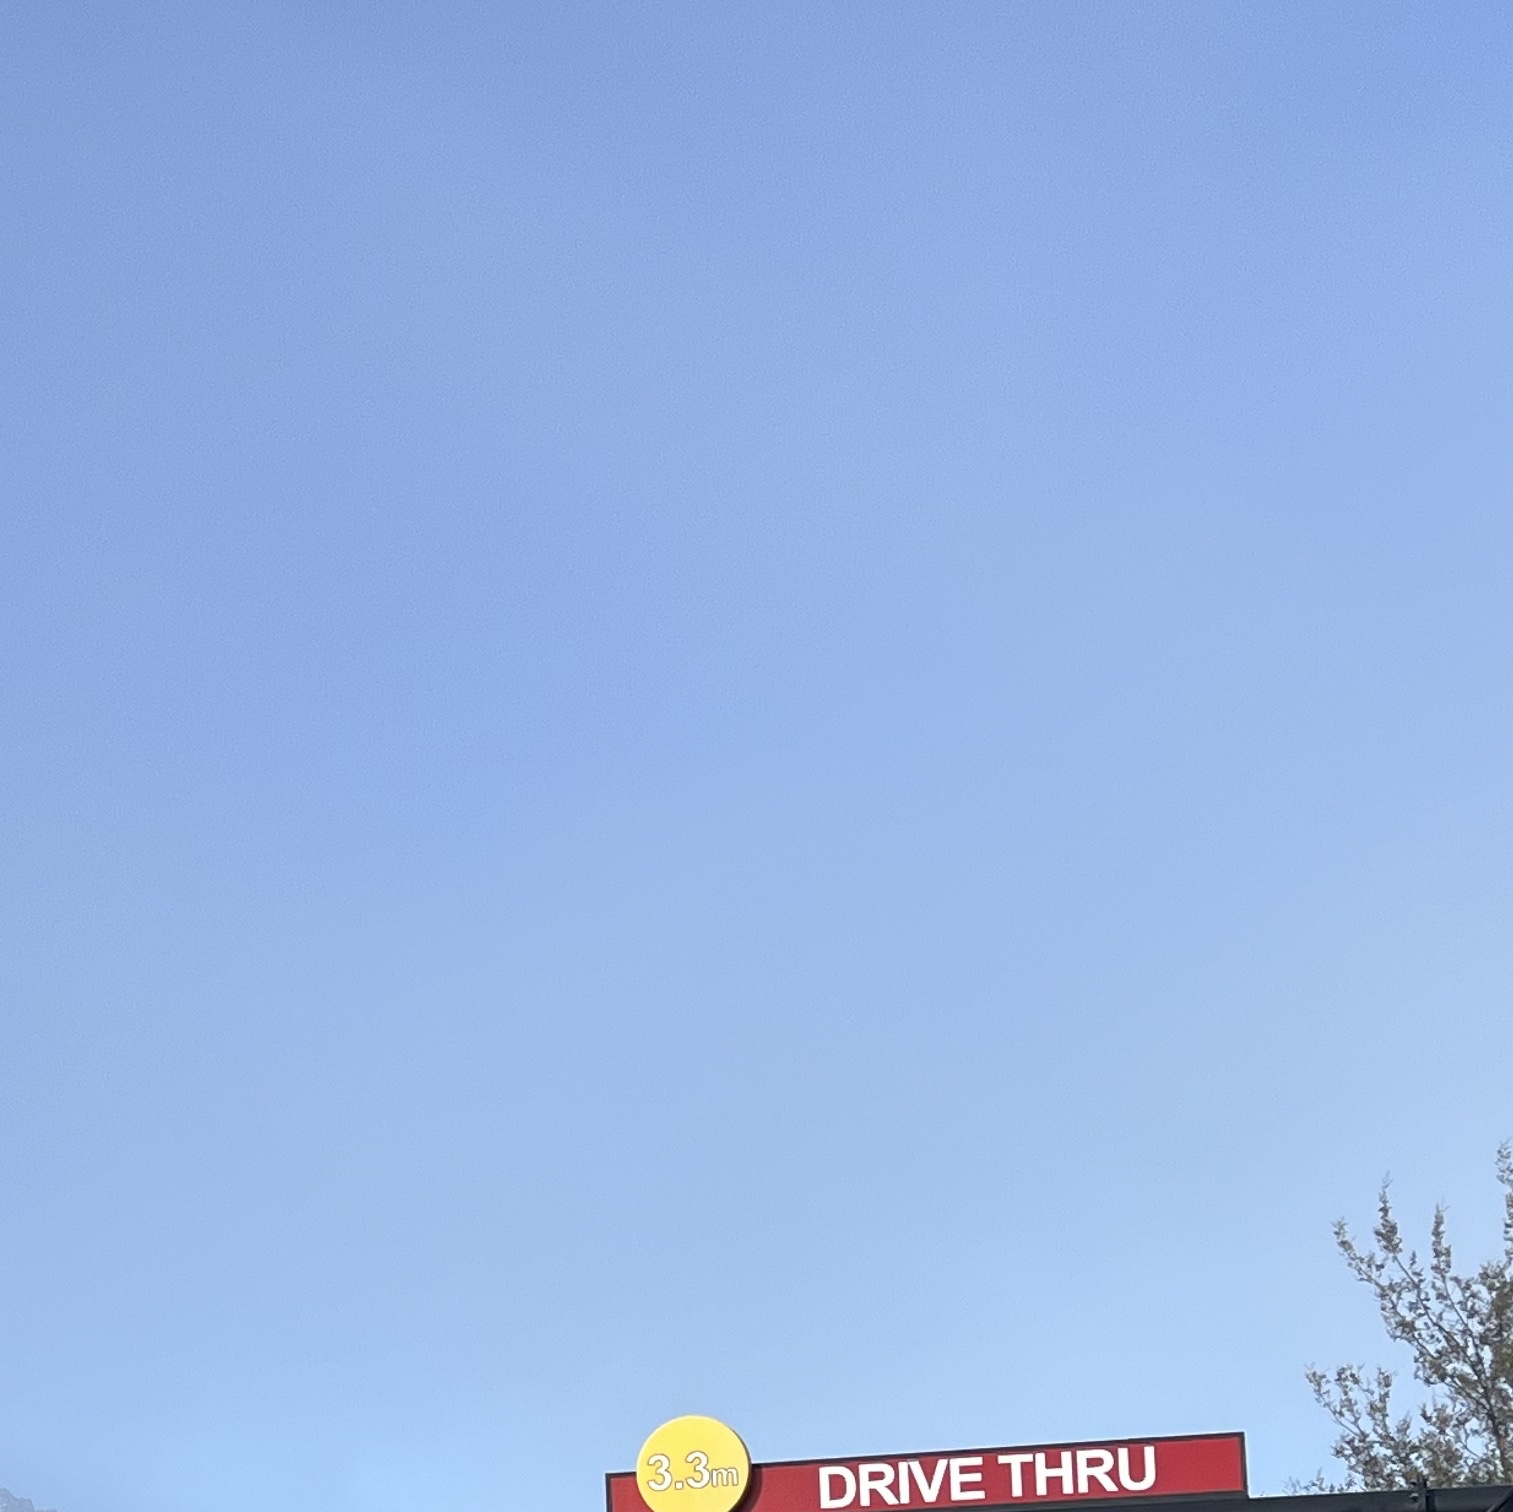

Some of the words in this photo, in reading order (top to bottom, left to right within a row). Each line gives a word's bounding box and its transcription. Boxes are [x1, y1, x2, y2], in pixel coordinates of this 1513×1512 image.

[646, 1450, 740, 1492] 3.3m
[819, 1456, 987, 1510] DRIVE
[997, 1445, 1157, 1498] THRU
